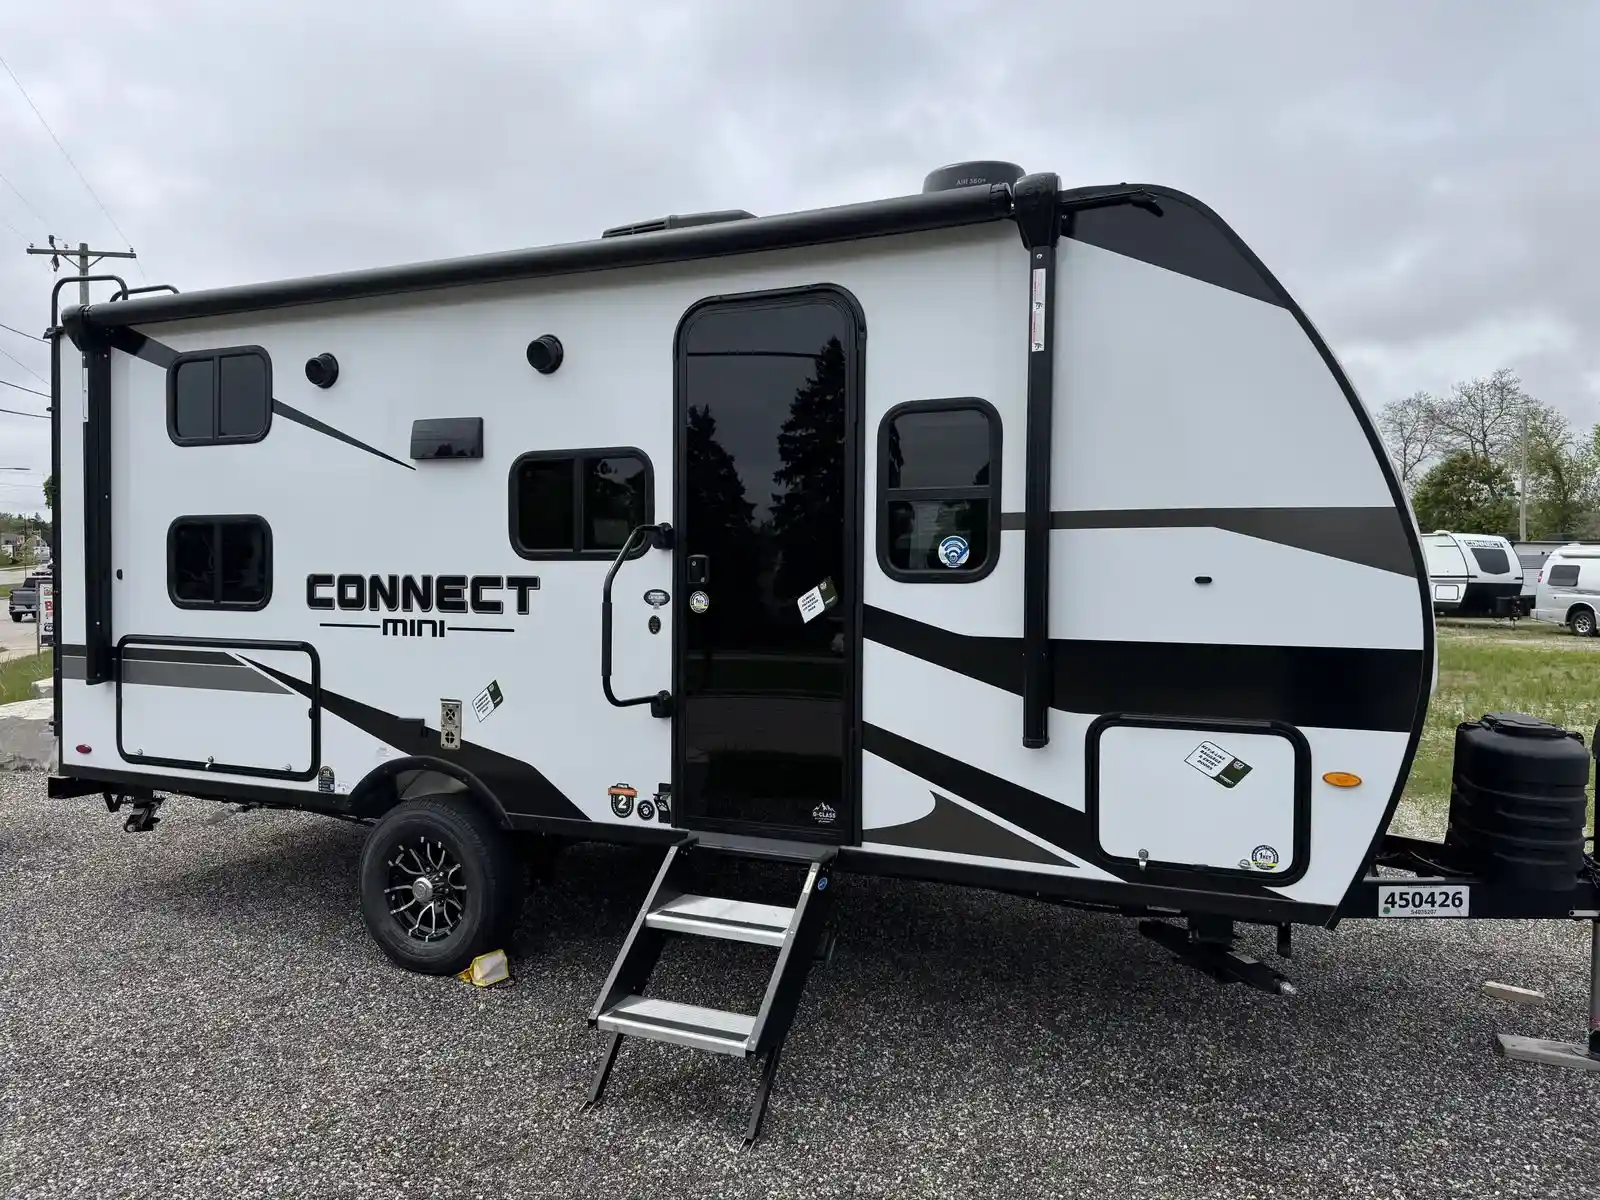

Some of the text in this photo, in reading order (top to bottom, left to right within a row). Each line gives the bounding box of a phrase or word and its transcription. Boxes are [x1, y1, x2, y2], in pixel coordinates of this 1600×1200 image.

[306, 573, 541, 615] CONNECT
[618, 795, 627, 809] 2
[1383, 891, 1464, 908] 450426
